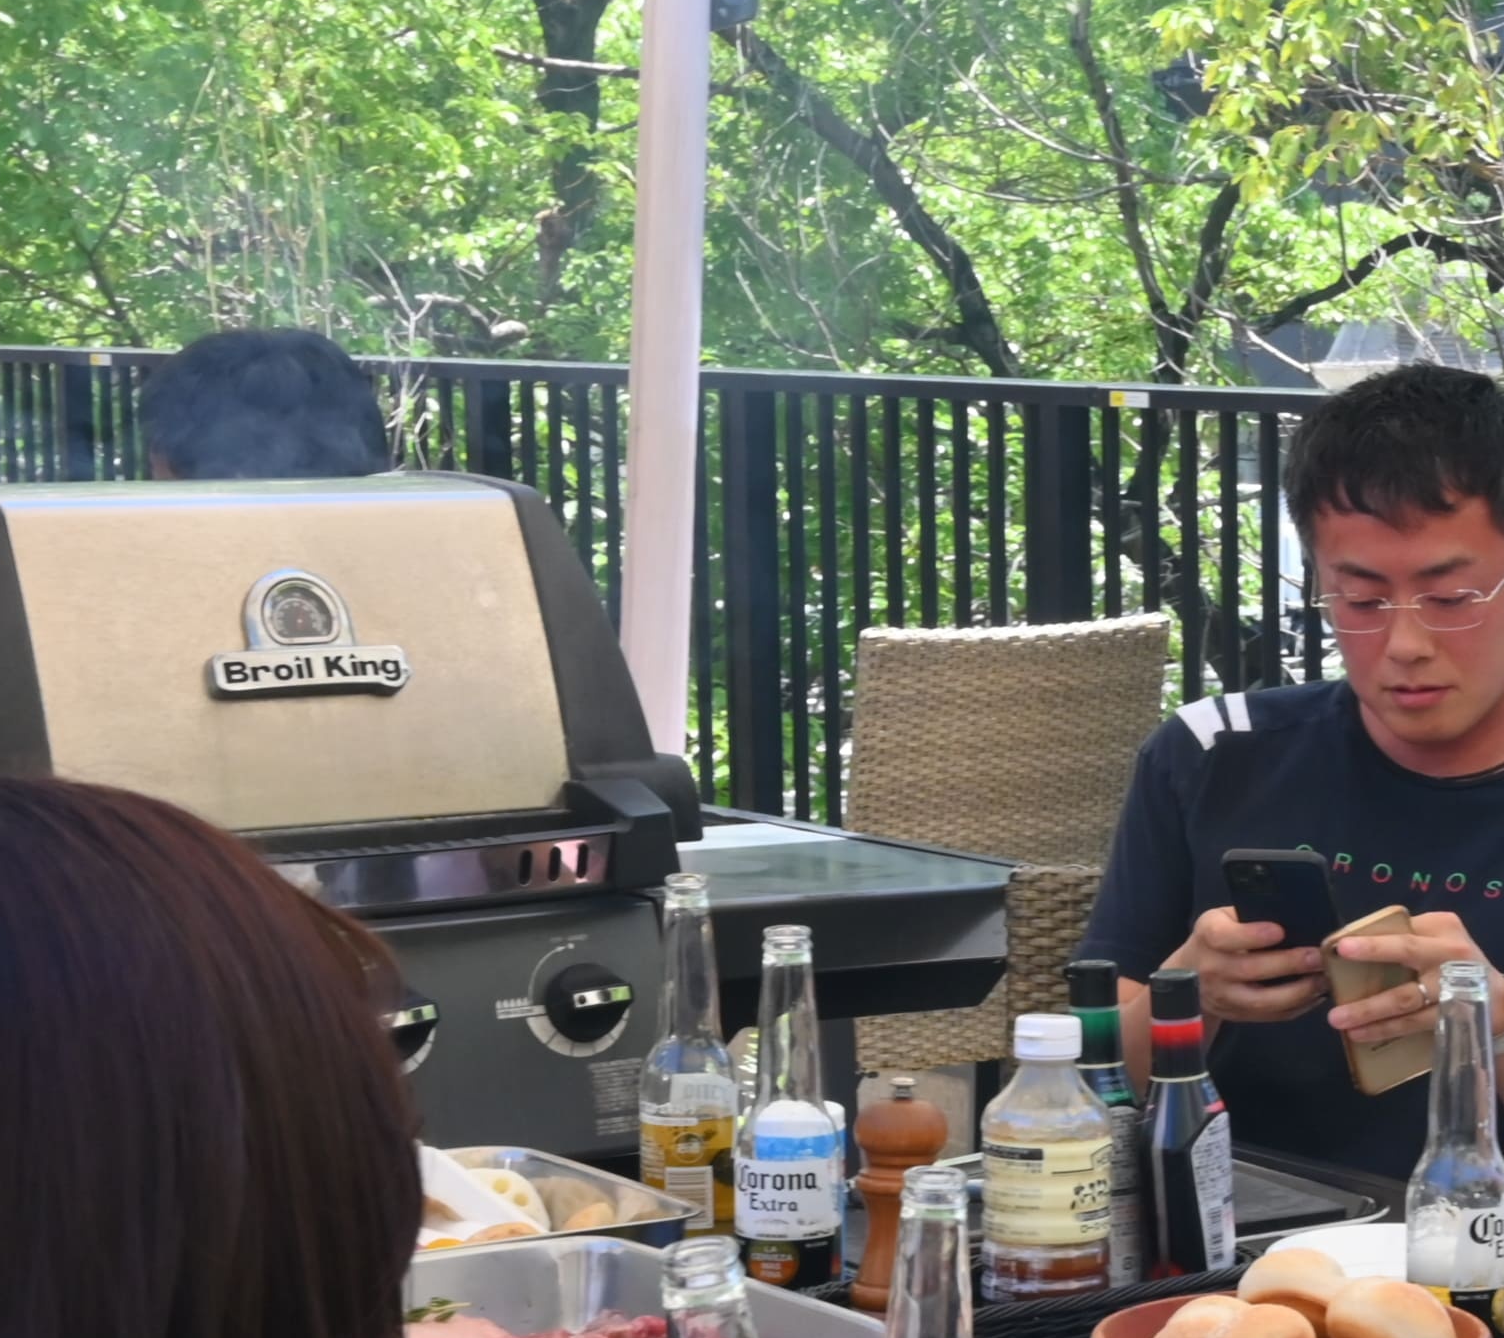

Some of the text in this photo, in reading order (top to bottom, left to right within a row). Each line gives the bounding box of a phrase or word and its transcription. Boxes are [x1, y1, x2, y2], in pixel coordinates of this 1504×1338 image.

[222, 654, 402, 685] Broil King
[748, 1192, 799, 1213] Extra
